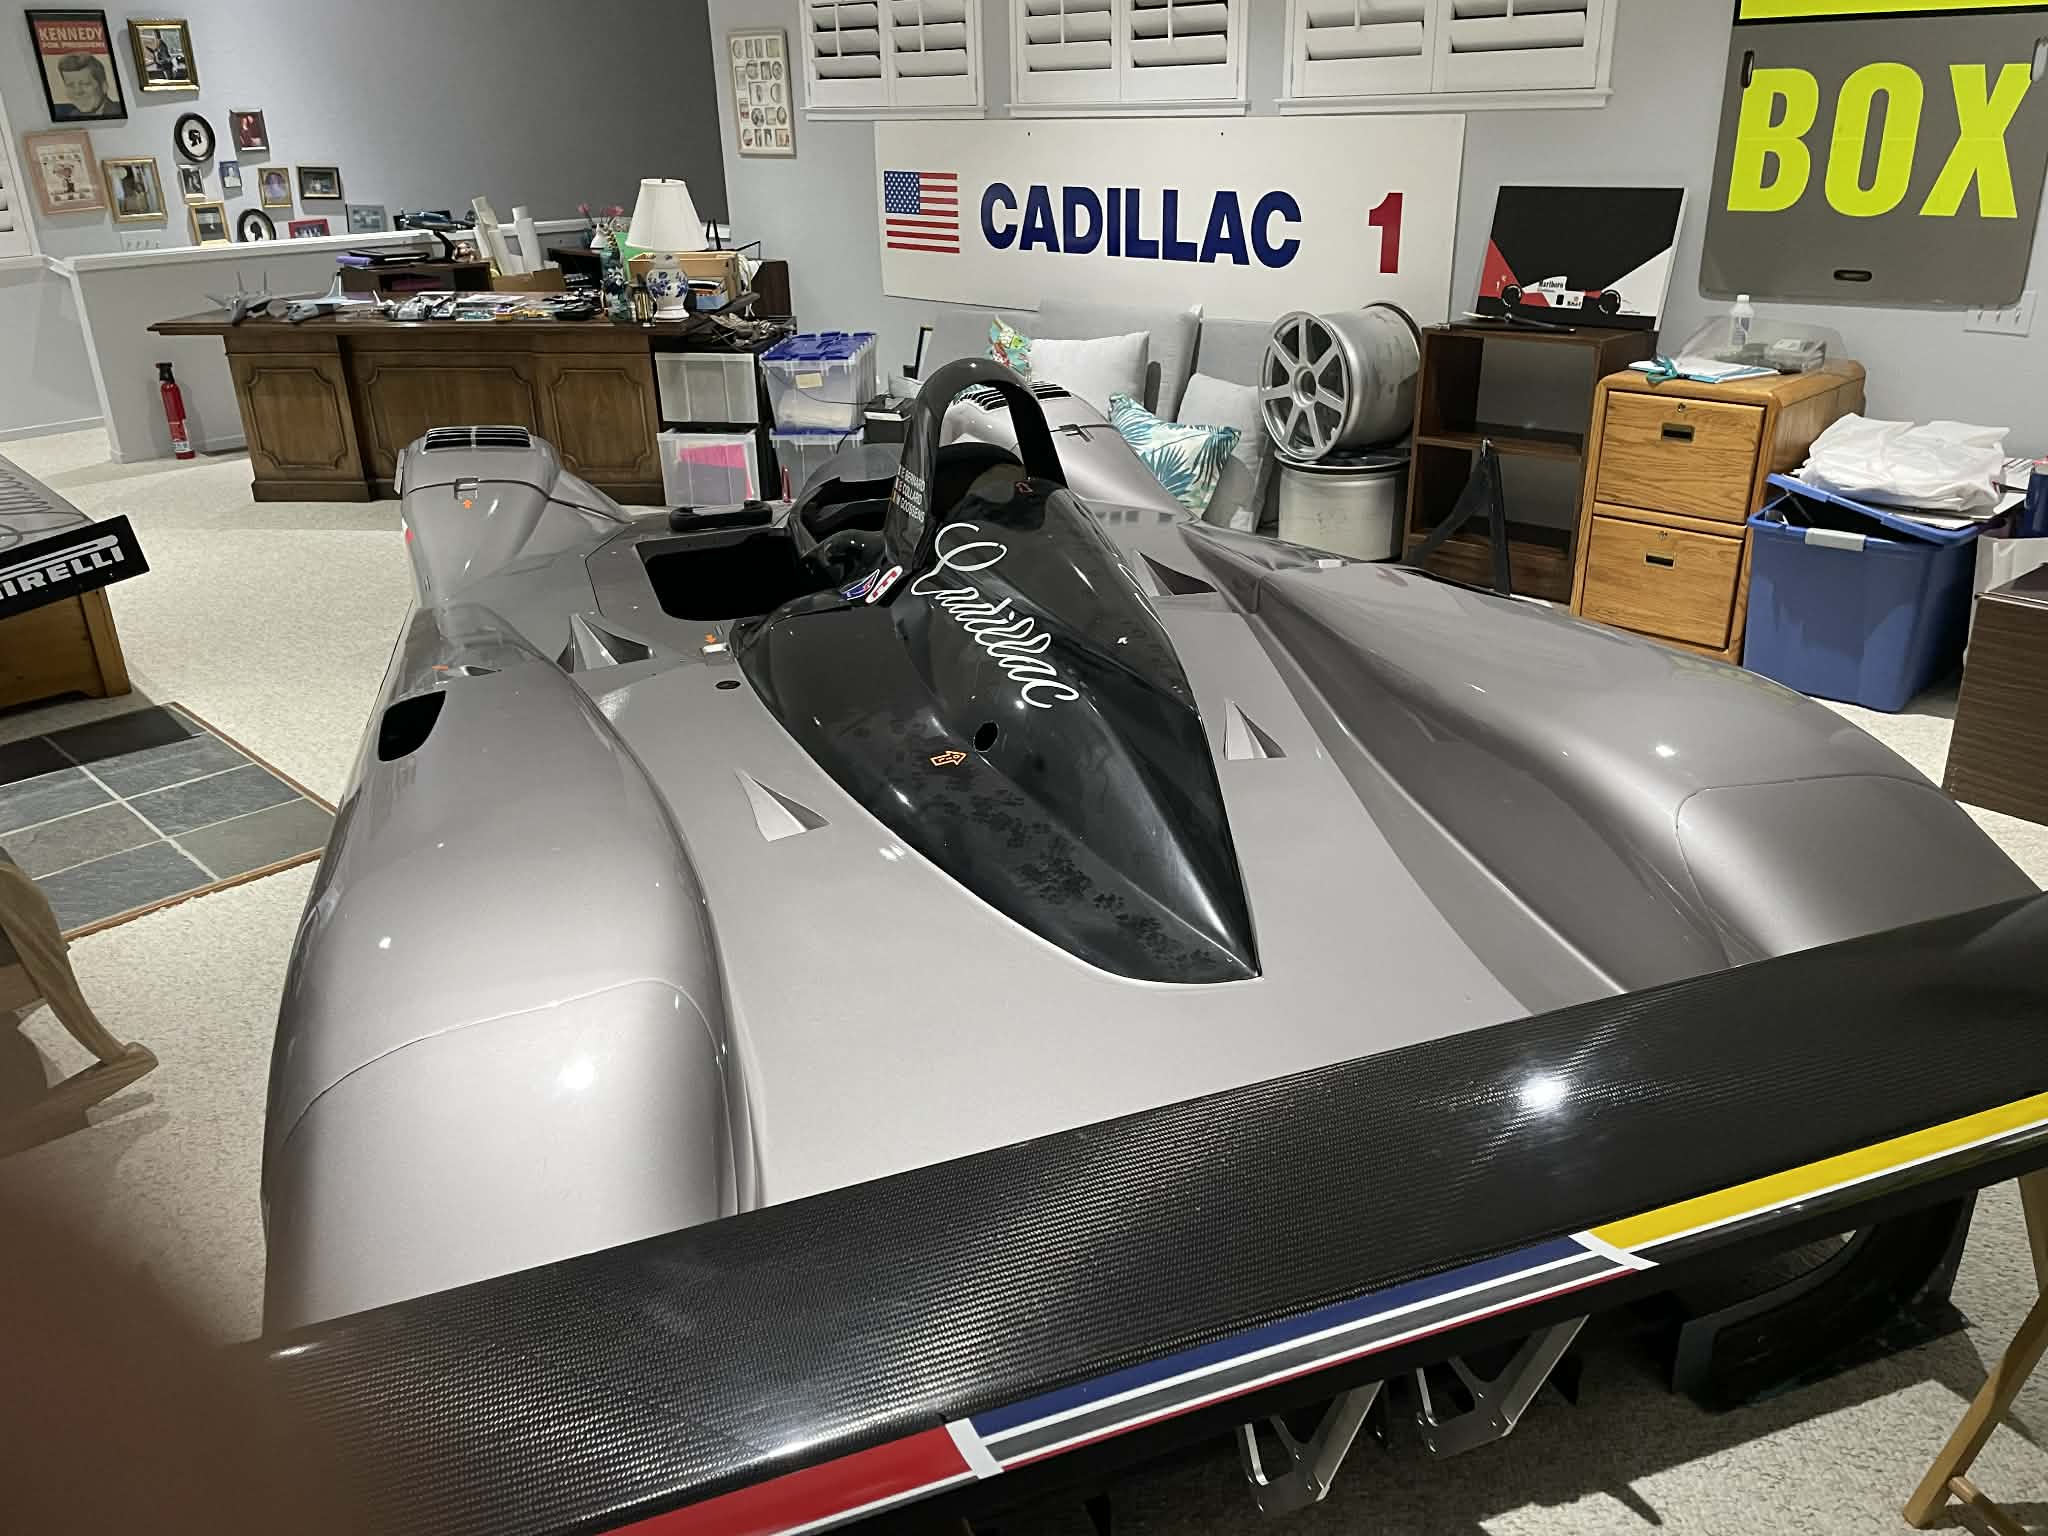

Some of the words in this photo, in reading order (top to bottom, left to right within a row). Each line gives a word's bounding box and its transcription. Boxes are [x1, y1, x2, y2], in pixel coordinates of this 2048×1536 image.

[39, 27, 104, 41] KENNEDY
[1727, 62, 2032, 219] BOX
[980, 182, 1301, 268] CADILLAC
[1368, 192, 1404, 274] 1
[902, 483, 923, 506] COLLARD
[911, 522, 1080, 708] Cadillac
